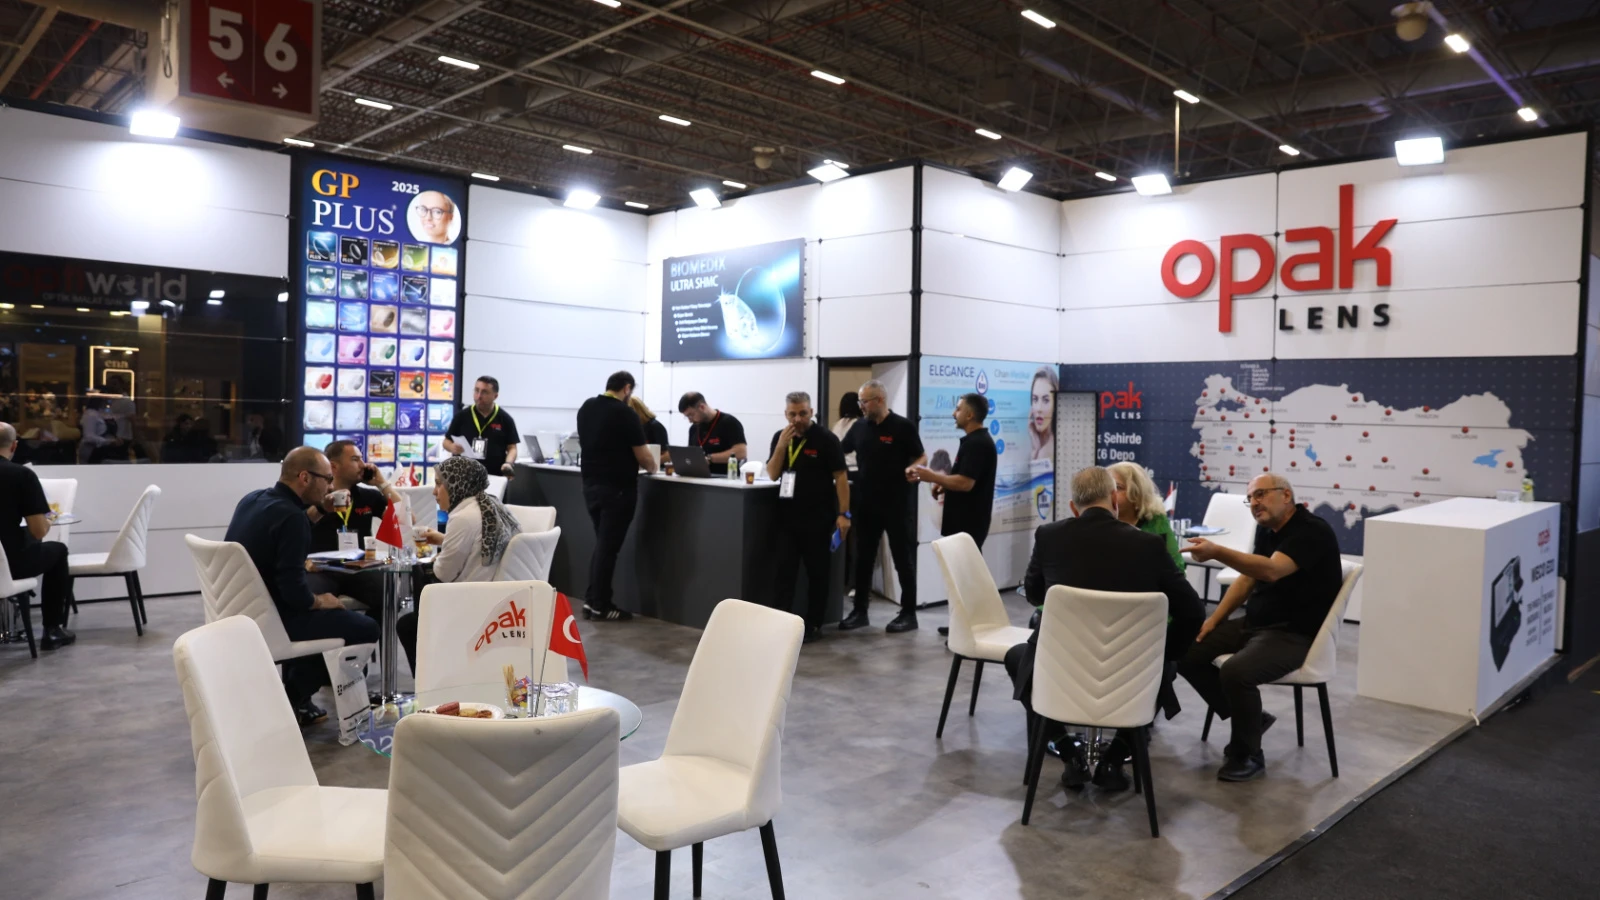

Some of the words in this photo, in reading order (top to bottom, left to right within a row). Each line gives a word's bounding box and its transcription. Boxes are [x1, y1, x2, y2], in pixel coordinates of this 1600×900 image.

[208, 6, 244, 61] 5
[264, 23, 298, 72] 6
[312, 169, 359, 198] GP
[392, 181, 419, 194] 2025
[312, 199, 395, 235] PLUS
[670, 256, 727, 277] BIOMEDIX
[1160, 184, 1398, 333] opak
[670, 278, 694, 292] ULTRA
[695, 275, 718, 289] SHMC
[1279, 303, 1391, 331] LENS
[929, 364, 975, 378] ELEGANCE
[1100, 381, 1142, 419] pak
[1114, 412, 1142, 420] LENS
[1104, 432, 1142, 446] Şehirde
[1110, 449, 1135, 462] Depo
[475, 600, 526, 651] opak
[502, 630, 526, 639] LENS
